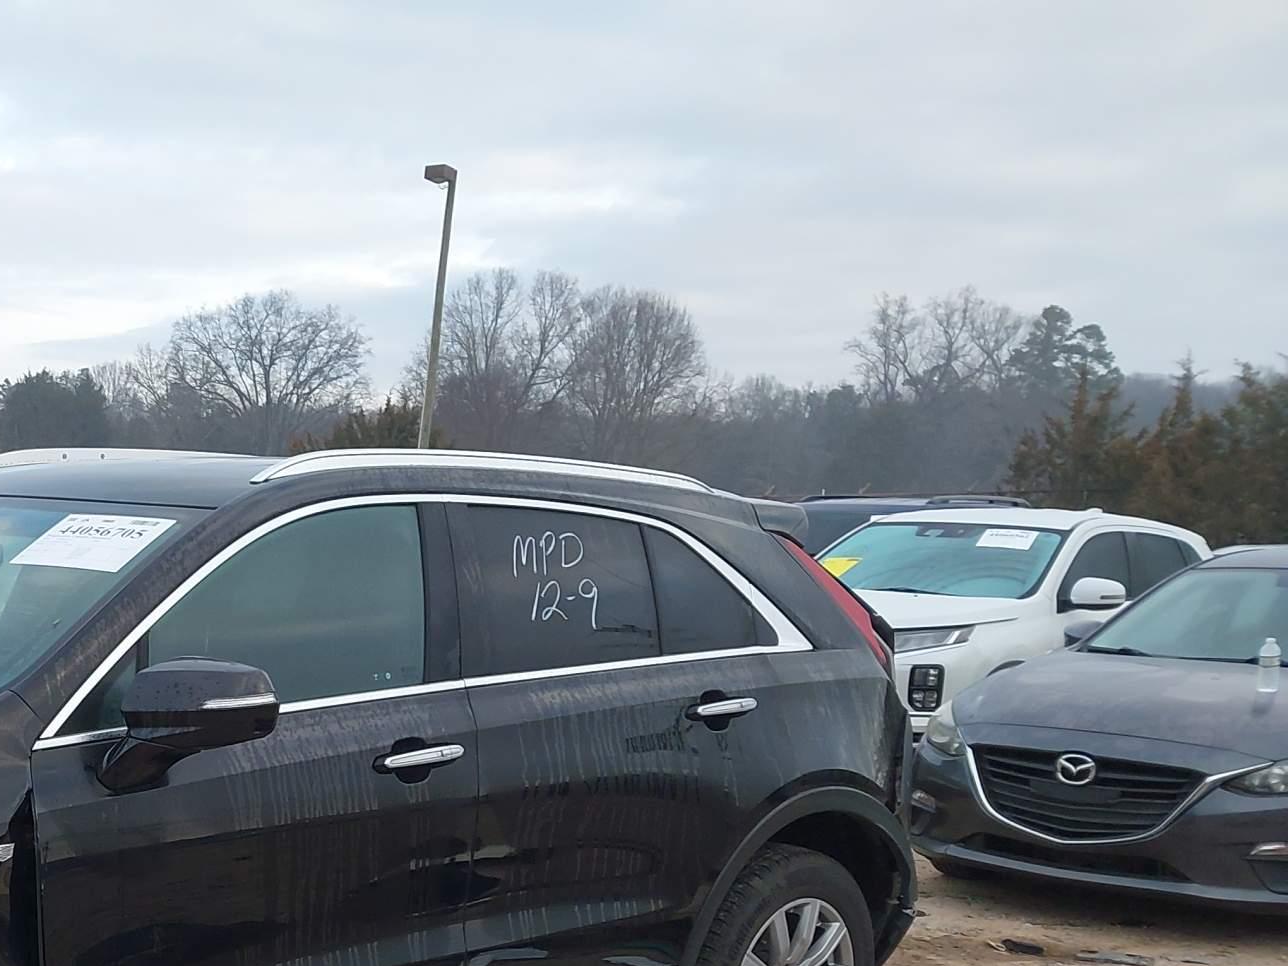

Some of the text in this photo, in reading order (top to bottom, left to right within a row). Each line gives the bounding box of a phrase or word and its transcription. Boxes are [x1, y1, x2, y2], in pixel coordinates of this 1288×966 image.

[60, 525, 147, 539] 44056705
[513, 531, 584, 577] MPD
[531, 578, 598, 630] 12-9
